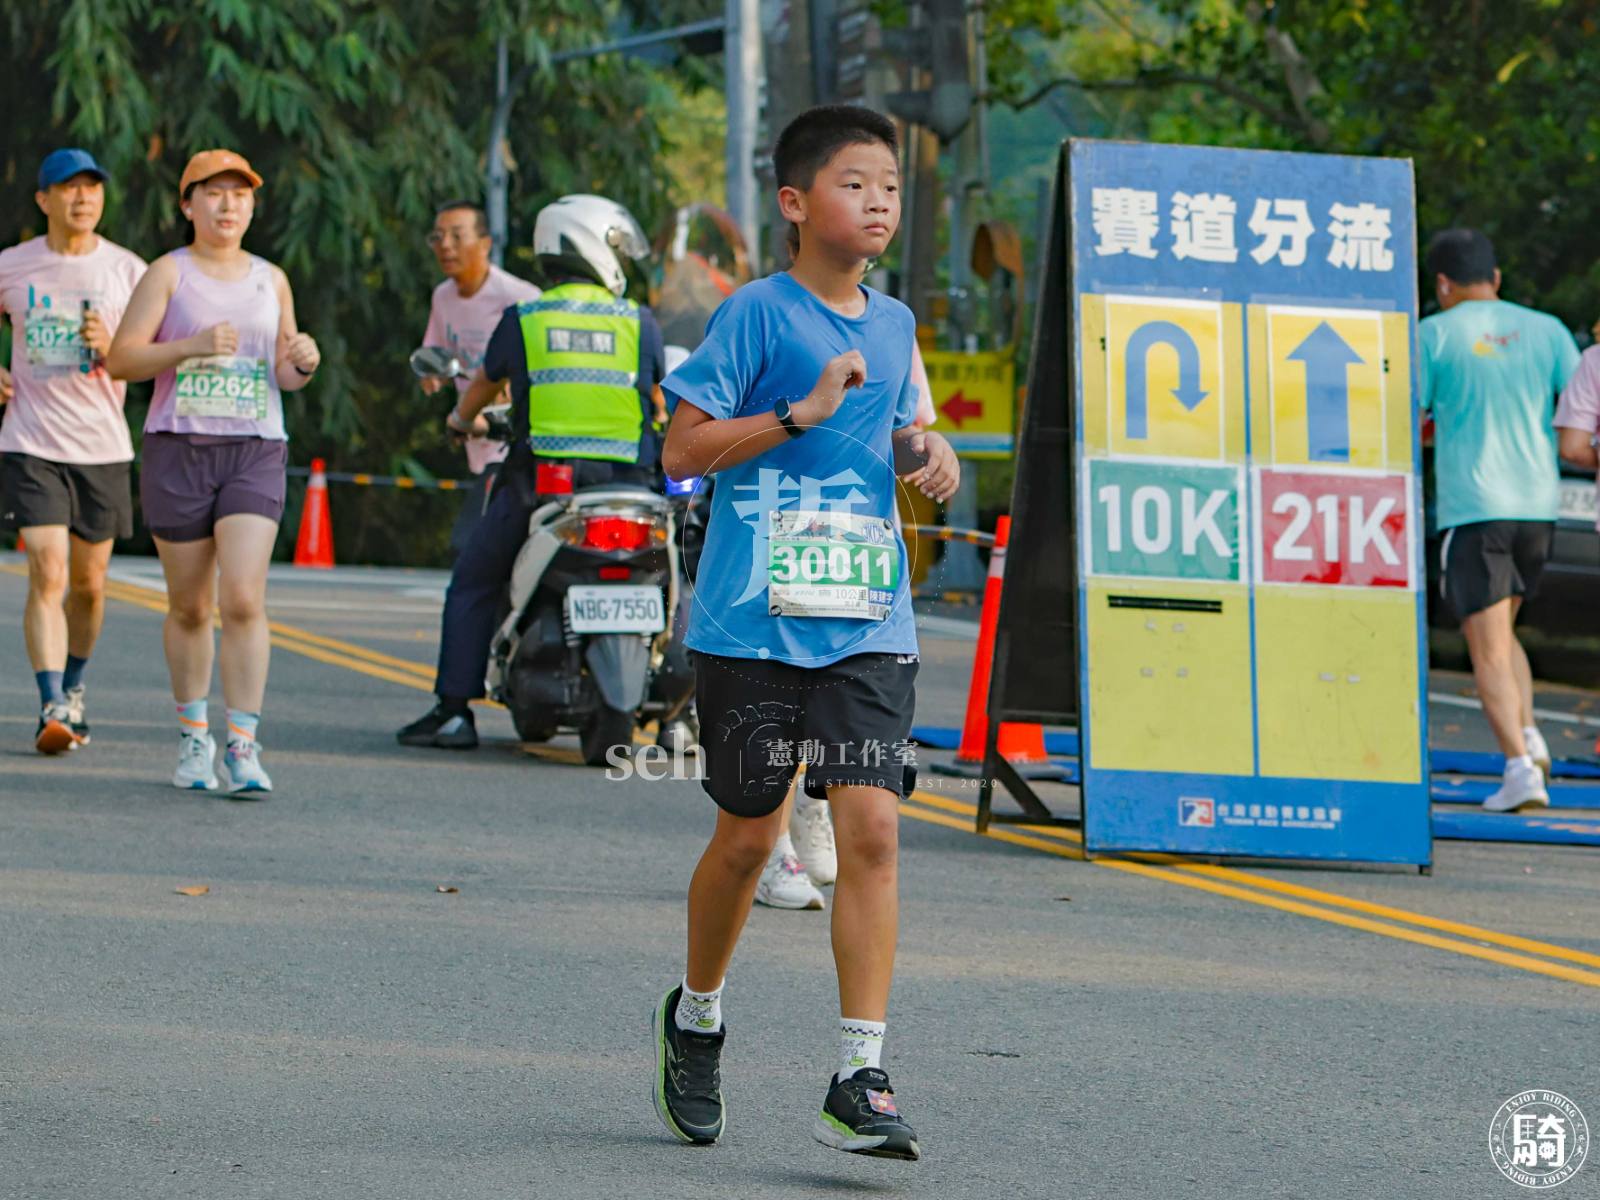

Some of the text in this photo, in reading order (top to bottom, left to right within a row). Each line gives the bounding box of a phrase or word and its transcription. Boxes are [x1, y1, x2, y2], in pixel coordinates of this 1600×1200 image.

[1091, 187, 1395, 272] 賽道分流
[27, 326, 86, 348] 3022
[177, 376, 255, 398] 40262
[1098, 484, 1233, 558] 10K
[1271, 491, 1401, 566] 21K
[771, 546, 891, 586] 30011
